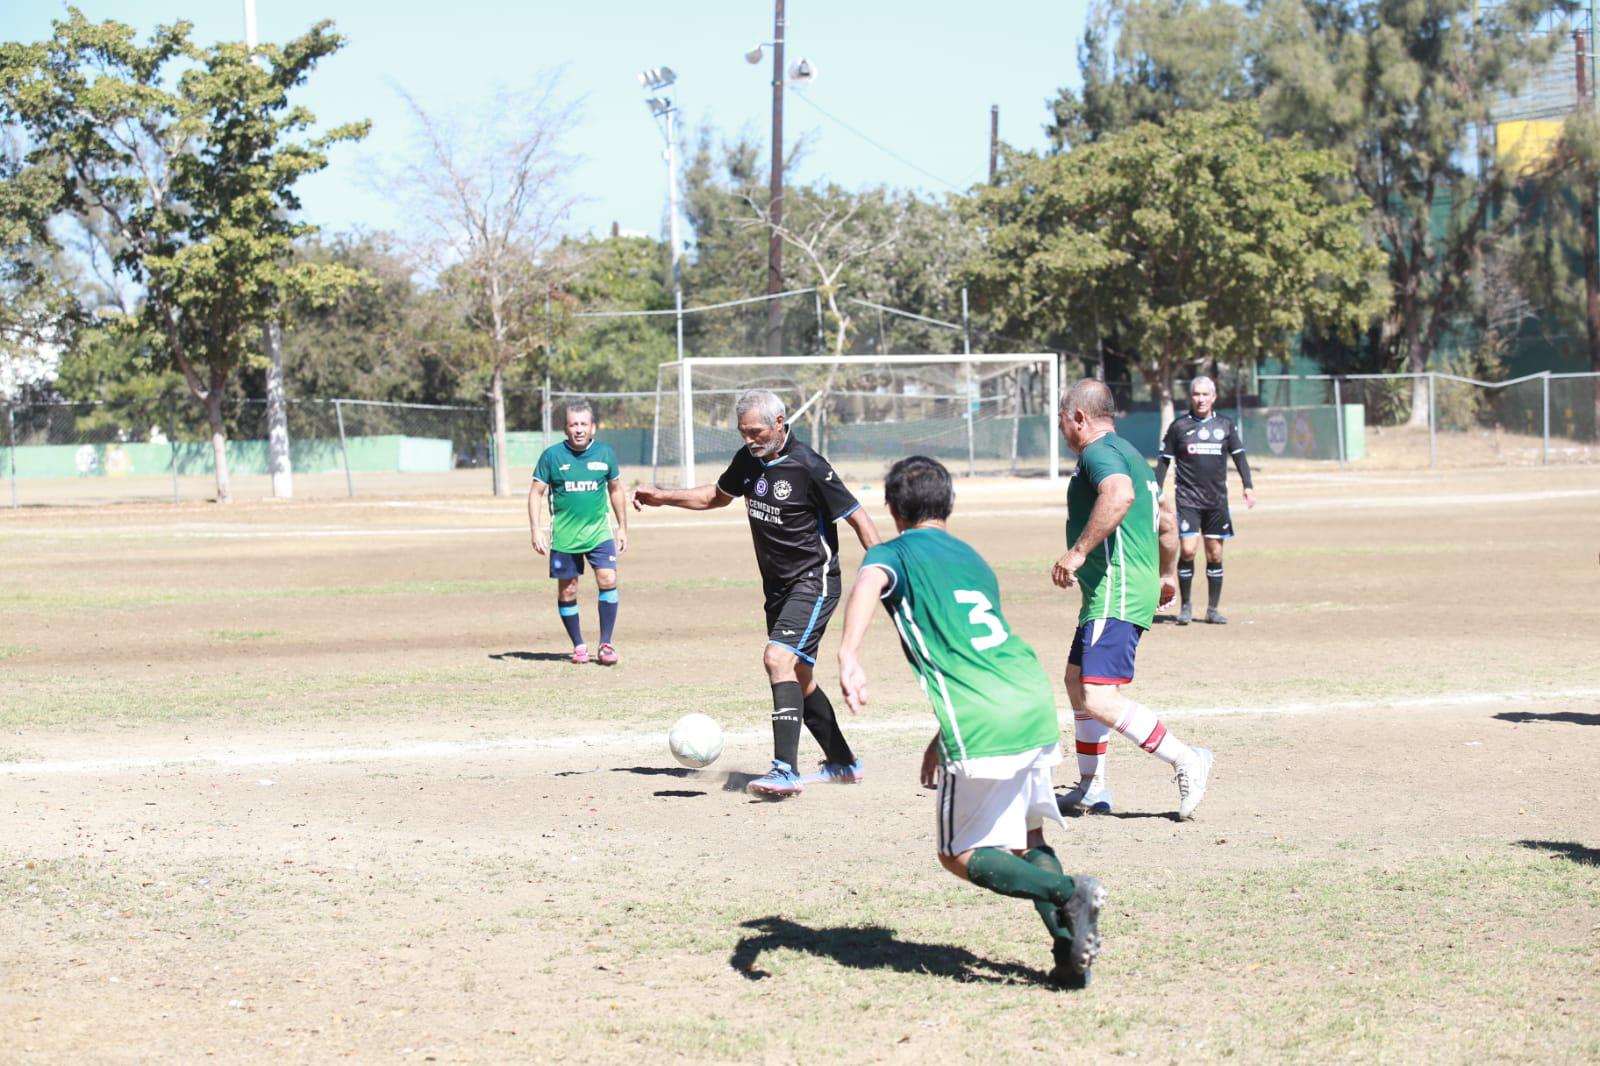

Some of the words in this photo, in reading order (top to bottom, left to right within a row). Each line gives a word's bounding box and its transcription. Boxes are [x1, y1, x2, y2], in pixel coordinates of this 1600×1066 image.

[565, 481, 598, 492] ELOTA
[750, 499, 780, 515] CEMENTO
[953, 589, 1009, 652] 3
